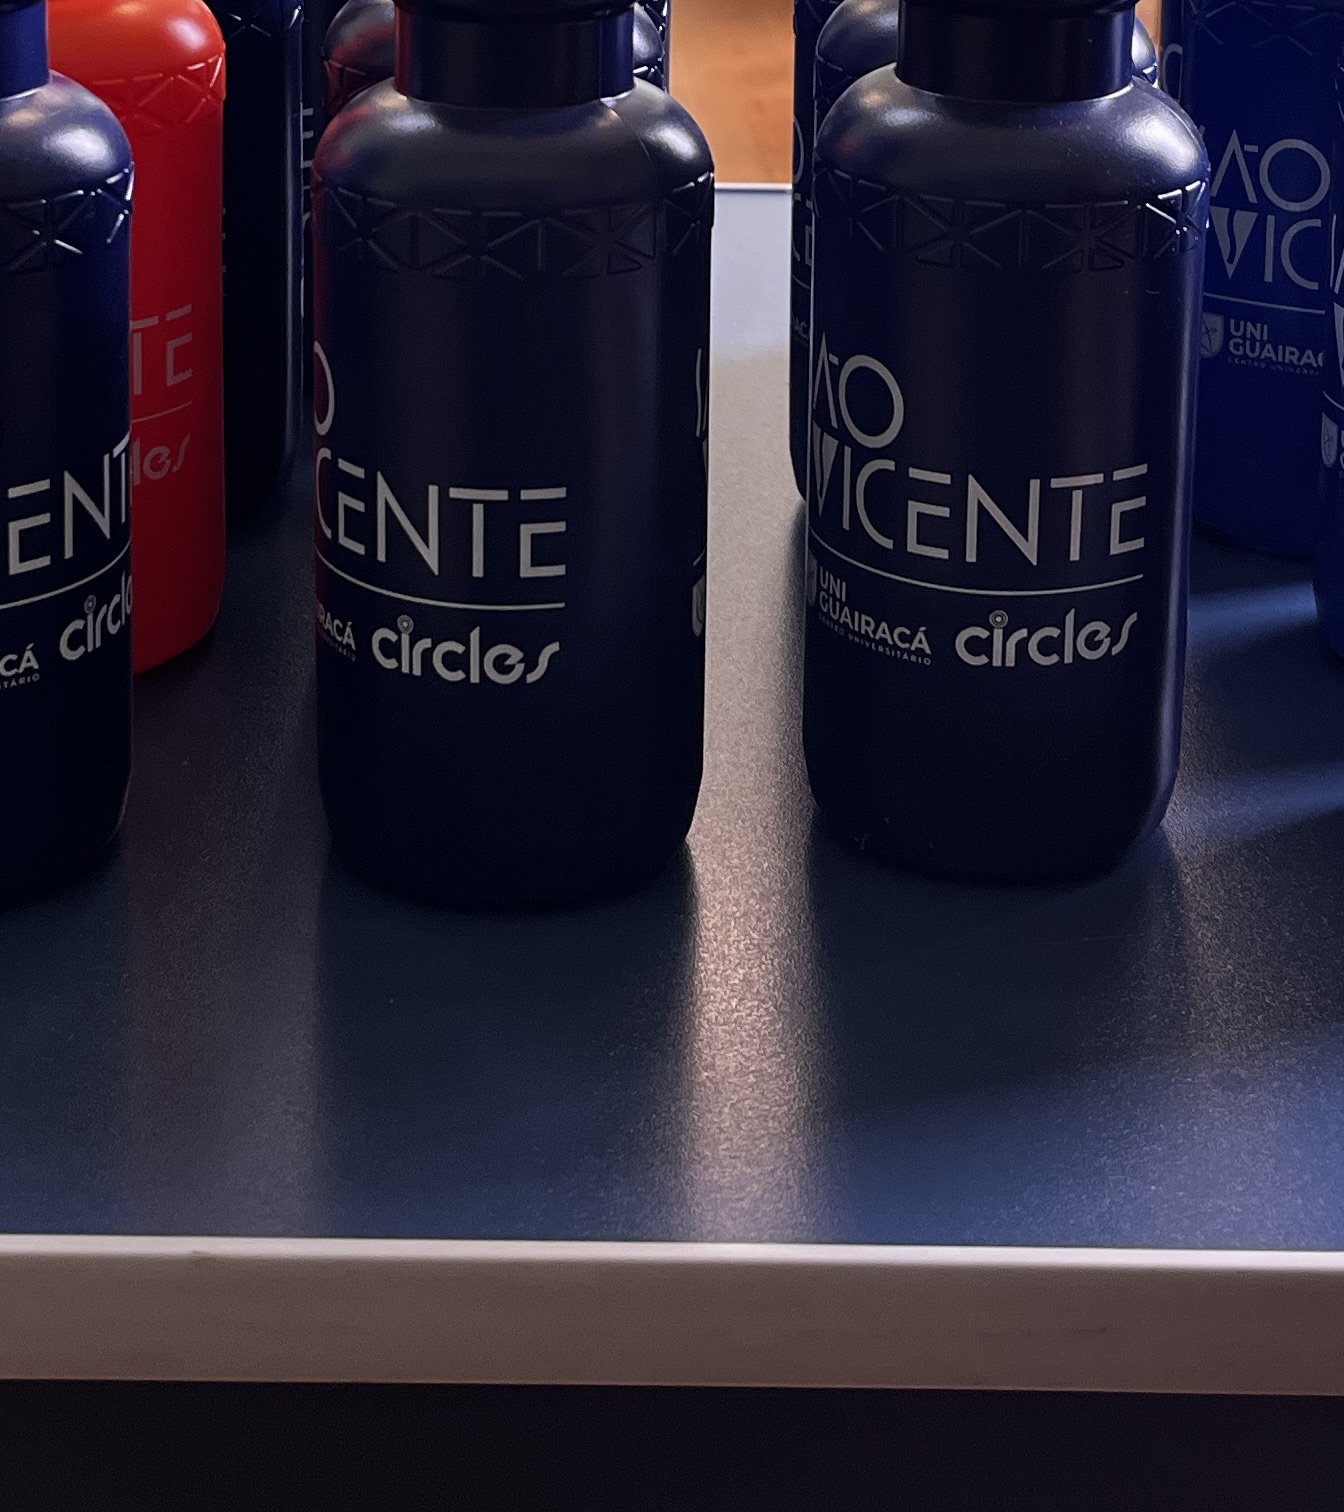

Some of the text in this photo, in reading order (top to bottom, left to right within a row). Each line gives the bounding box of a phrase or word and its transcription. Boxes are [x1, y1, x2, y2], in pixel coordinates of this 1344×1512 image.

[1229, 338, 1325, 369] GUAIRA
[1230, 317, 1268, 341] UNI
[812, 331, 905, 448] ÃO
[811, 463, 1148, 566] VICENTE
[818, 565, 847, 598] UNI
[371, 614, 561, 684] circles
[818, 592, 932, 655] GUAIRACÁ
[954, 607, 1139, 668] circles
